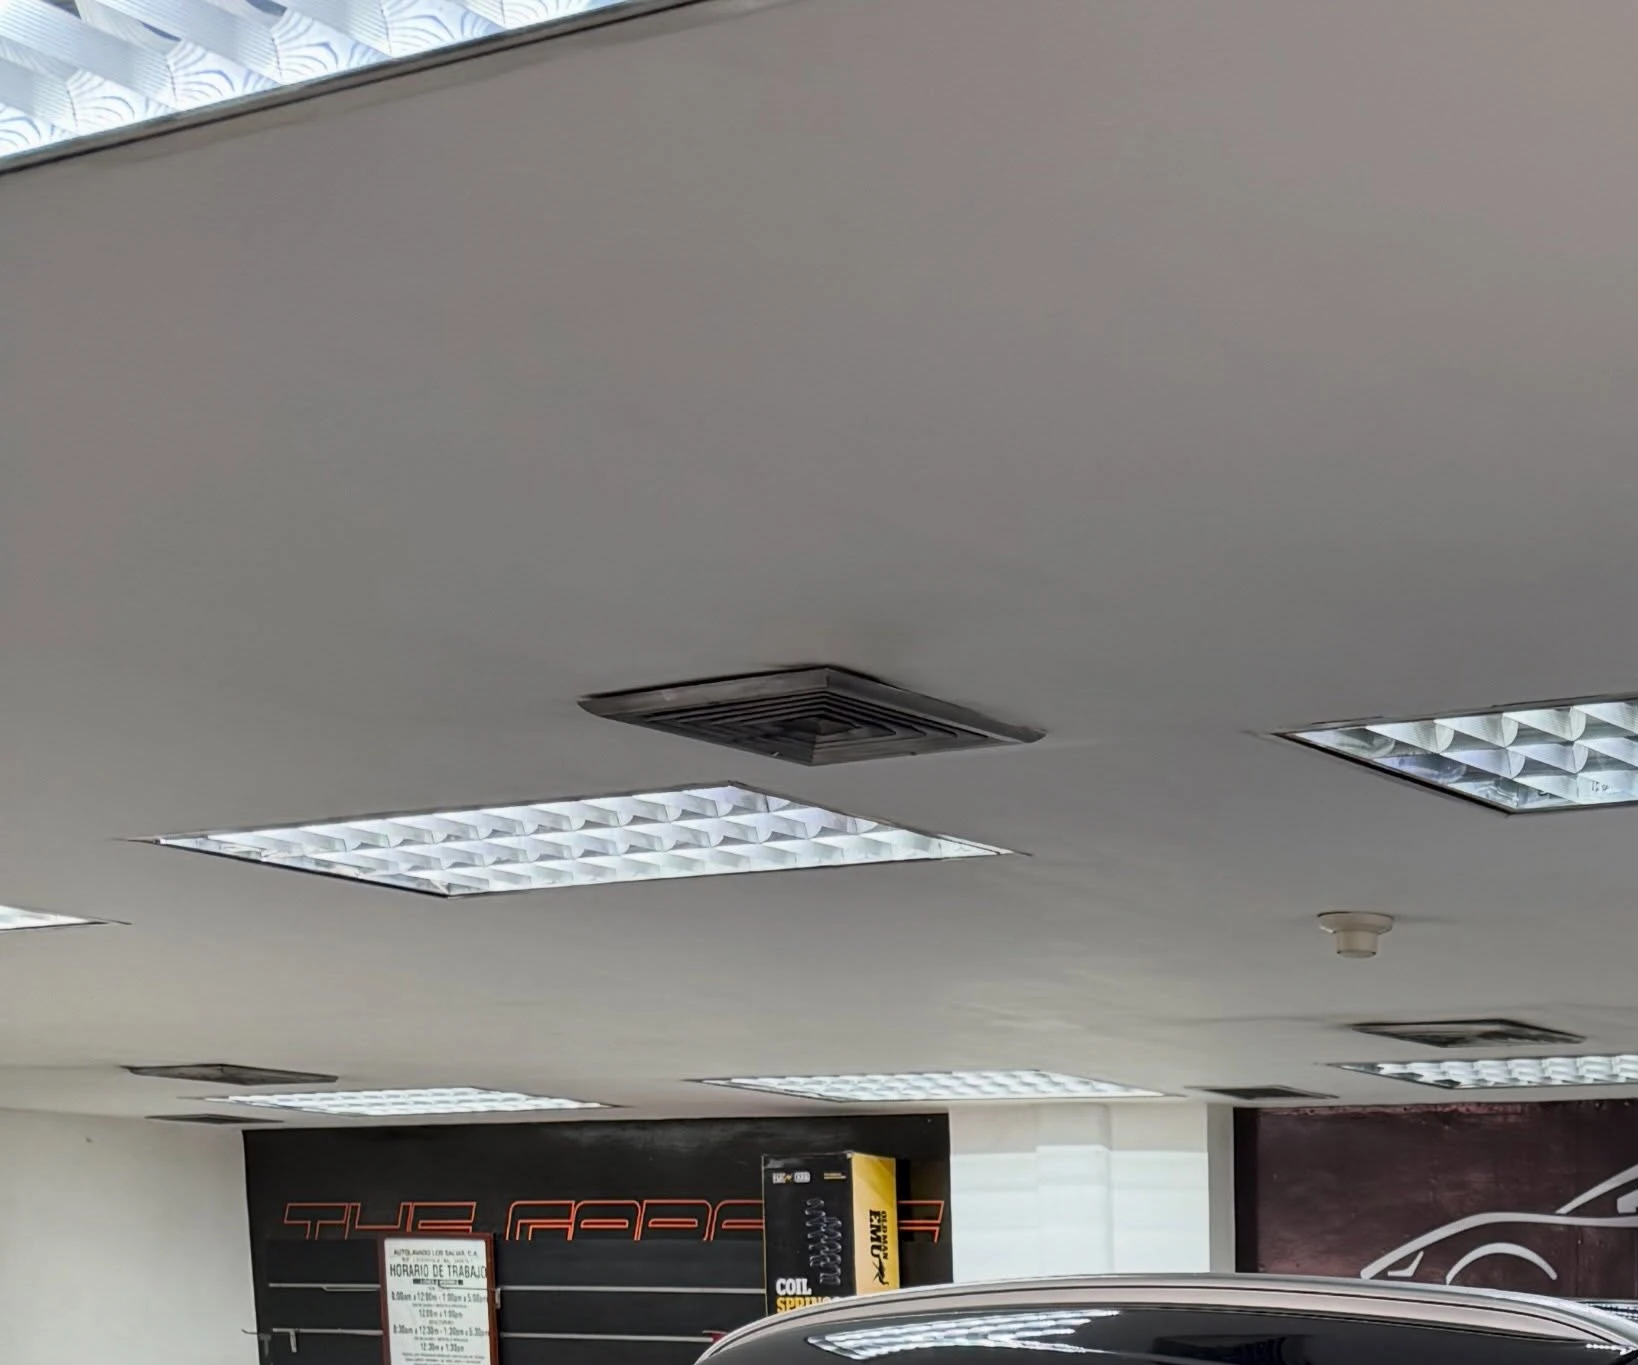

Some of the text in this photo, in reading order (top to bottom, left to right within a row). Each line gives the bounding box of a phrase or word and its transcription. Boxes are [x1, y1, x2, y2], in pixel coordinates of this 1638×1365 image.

[869, 1209, 882, 1259] EMU
[390, 1264, 487, 1279] HORARIO DE TRABAJO
[776, 1278, 812, 1296] COIL
